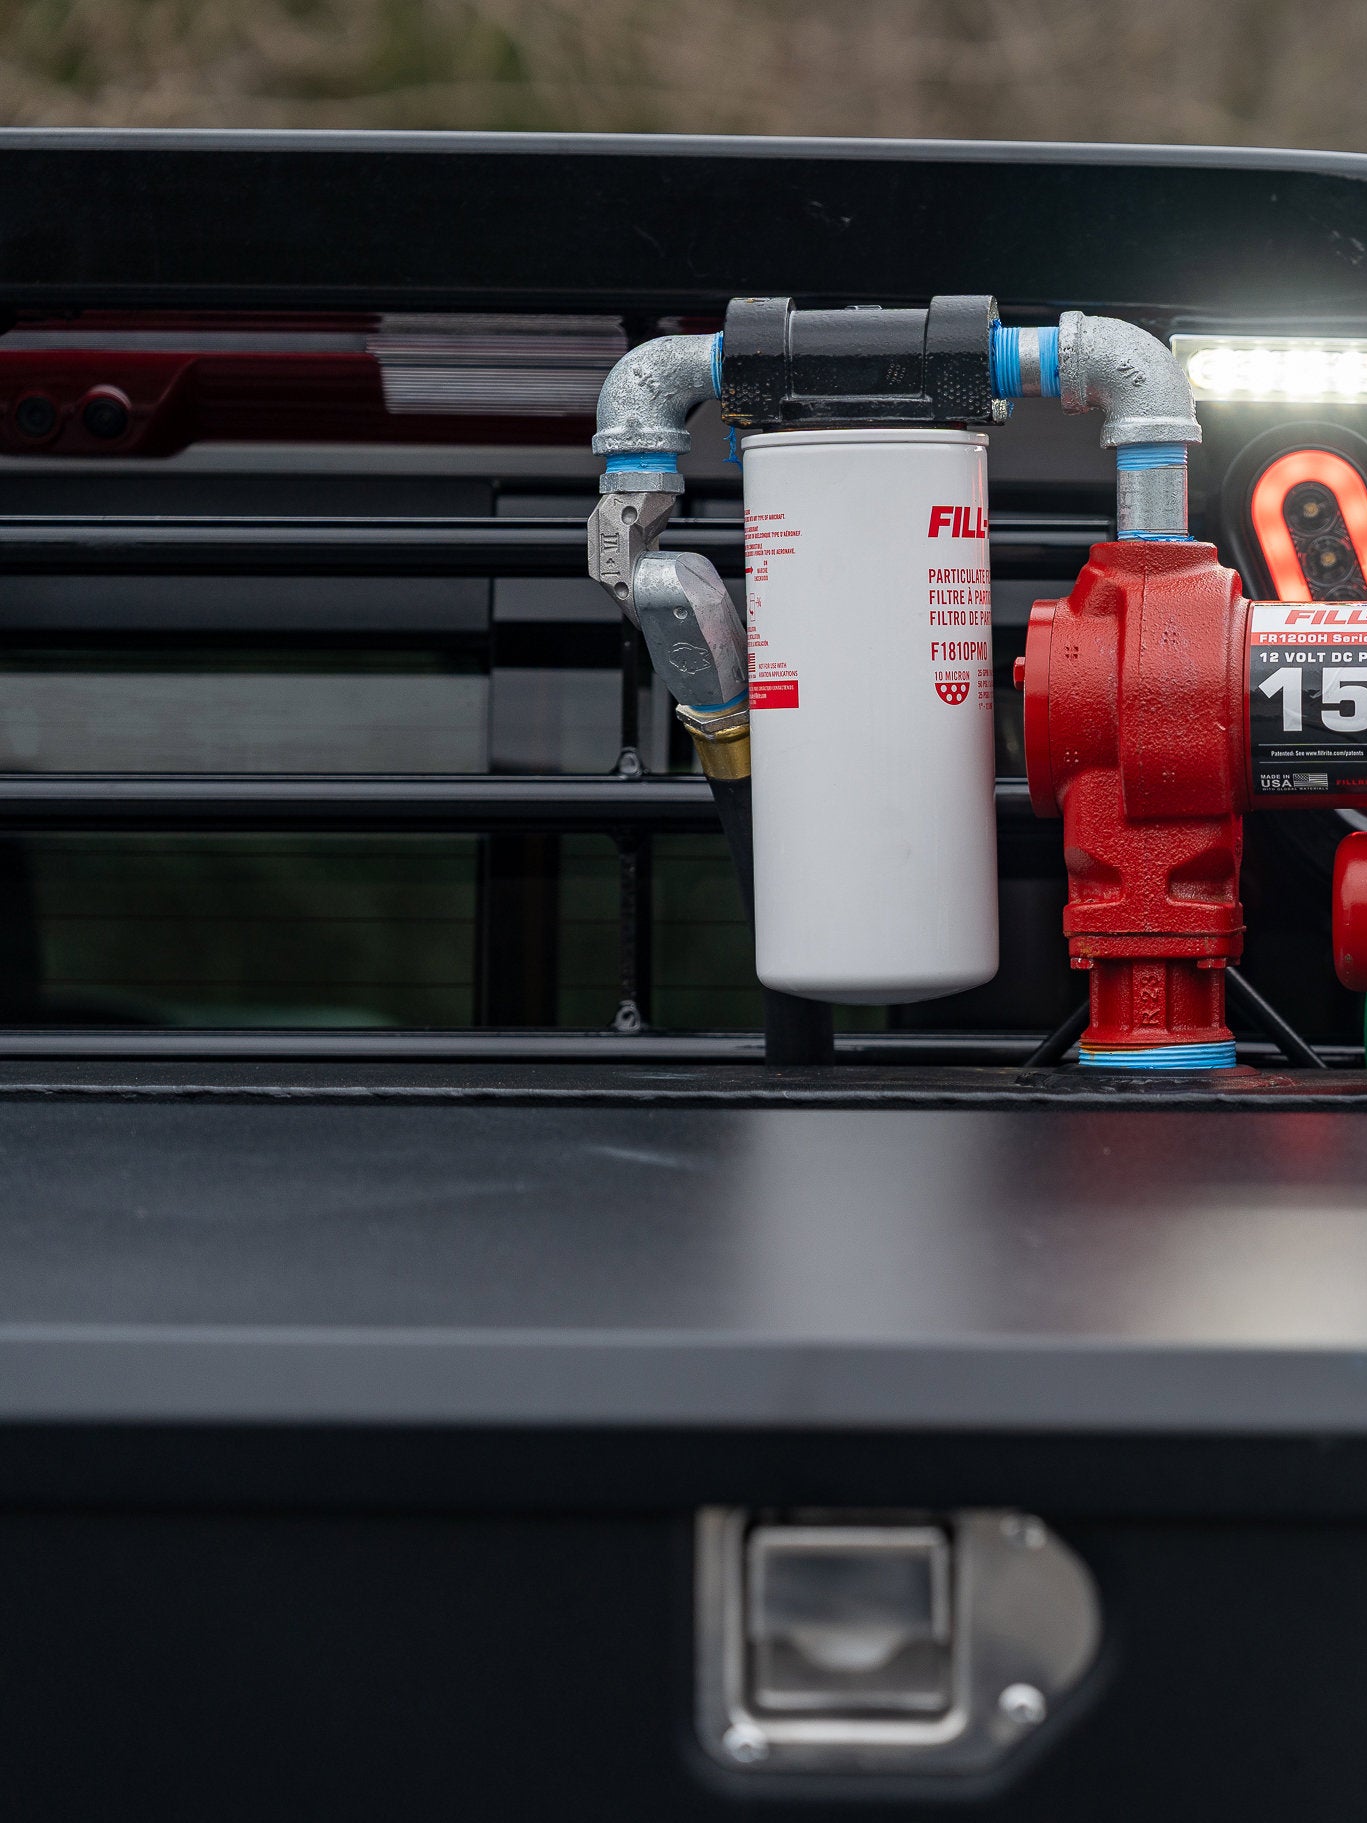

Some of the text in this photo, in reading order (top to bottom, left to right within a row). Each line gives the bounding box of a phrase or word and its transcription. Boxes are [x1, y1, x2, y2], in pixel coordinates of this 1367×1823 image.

[928, 505, 989, 538] FILL-
[928, 568, 985, 584] PARTICULATE
[929, 590, 966, 605] FILTRE
[967, 586, 973, 605] À
[930, 610, 967, 626] FILTRO
[969, 610, 979, 626] DE
[1259, 633, 1328, 643] FR1200H
[1259, 652, 1279, 663] 12
[1285, 652, 1326, 663] VOLT
[1331, 652, 1353, 663] DC
[934, 670, 970, 681] 10 MICRON
[1261, 779, 1293, 788] USA
